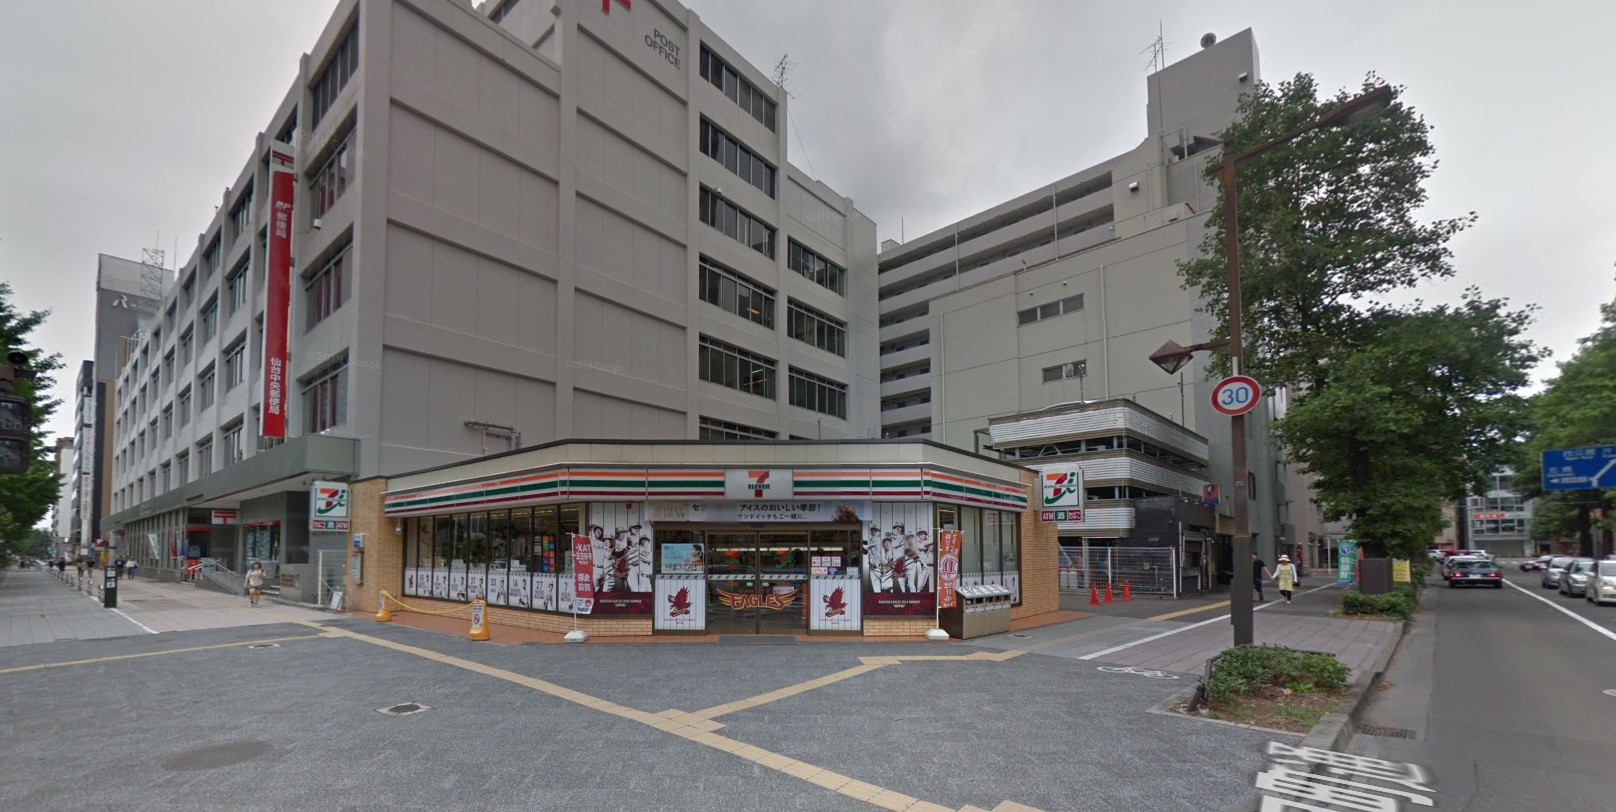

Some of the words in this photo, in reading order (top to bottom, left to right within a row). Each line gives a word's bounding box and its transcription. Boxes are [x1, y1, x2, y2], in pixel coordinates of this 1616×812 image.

[653, 28, 681, 57] POST
[644, 34, 681, 71] OFFICE
[269, 357, 281, 415] 仙台中央郵便局
[1222, 386, 1249, 405] 30
[1042, 511, 1054, 520] ATM
[535, 580, 543, 590] 27
[731, 594, 785, 610] EAGLES
